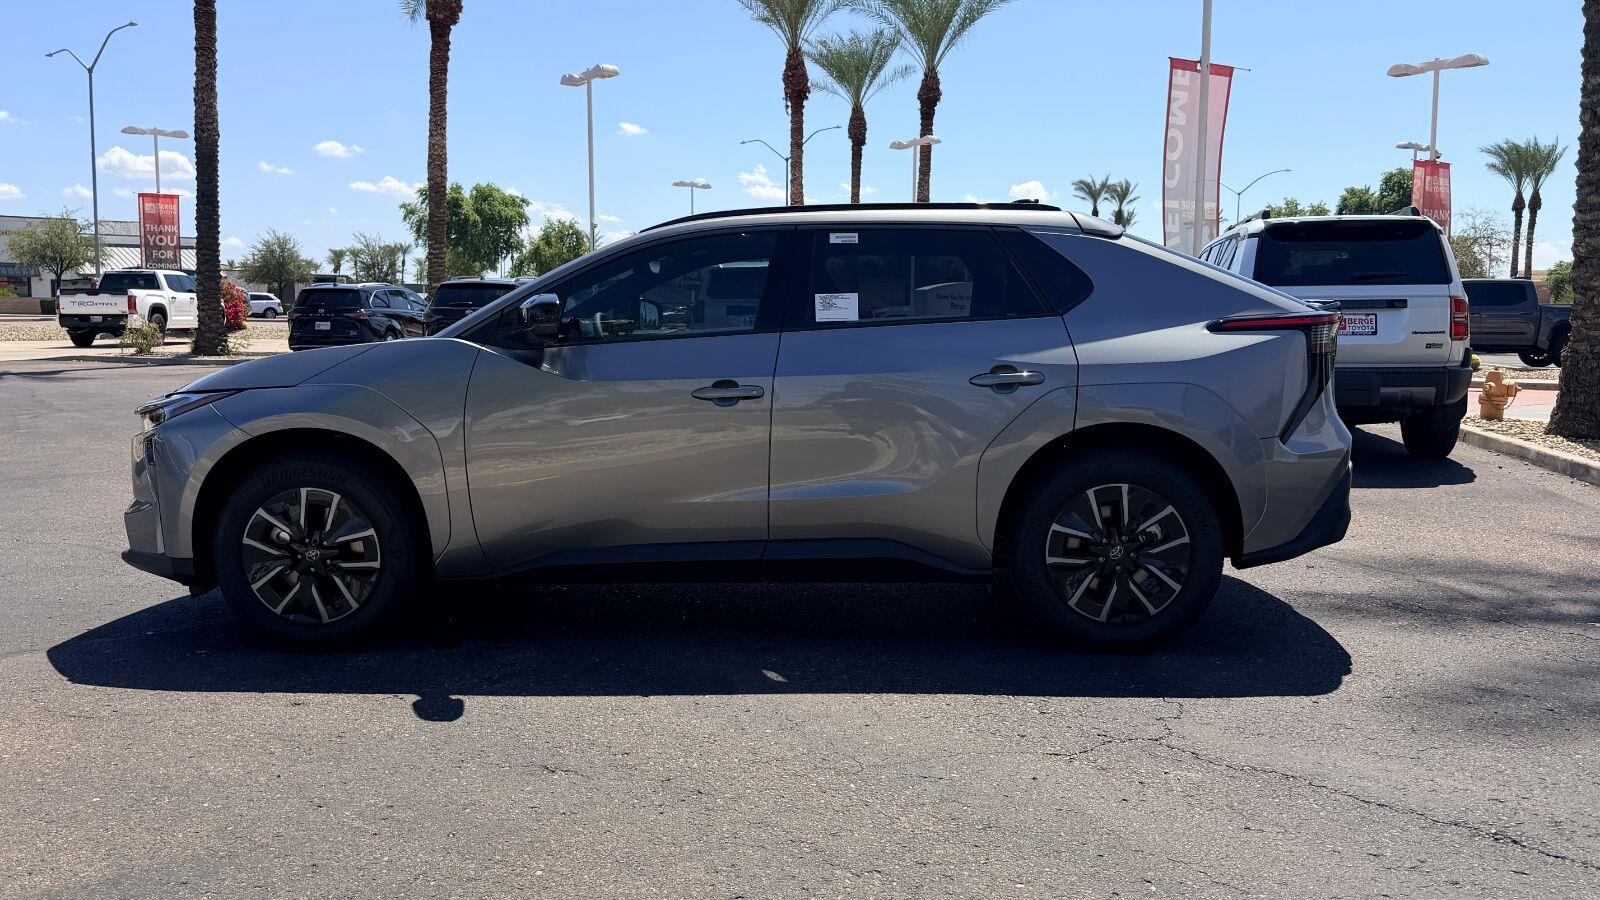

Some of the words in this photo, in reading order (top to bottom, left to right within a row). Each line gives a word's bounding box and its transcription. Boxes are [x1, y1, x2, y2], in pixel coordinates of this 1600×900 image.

[144, 224, 178, 233] THANK
[147, 234, 177, 246] YOU
[152, 250, 174, 259] FOR
[147, 262, 180, 270] COMING!
[1347, 317, 1374, 325] BERGE
